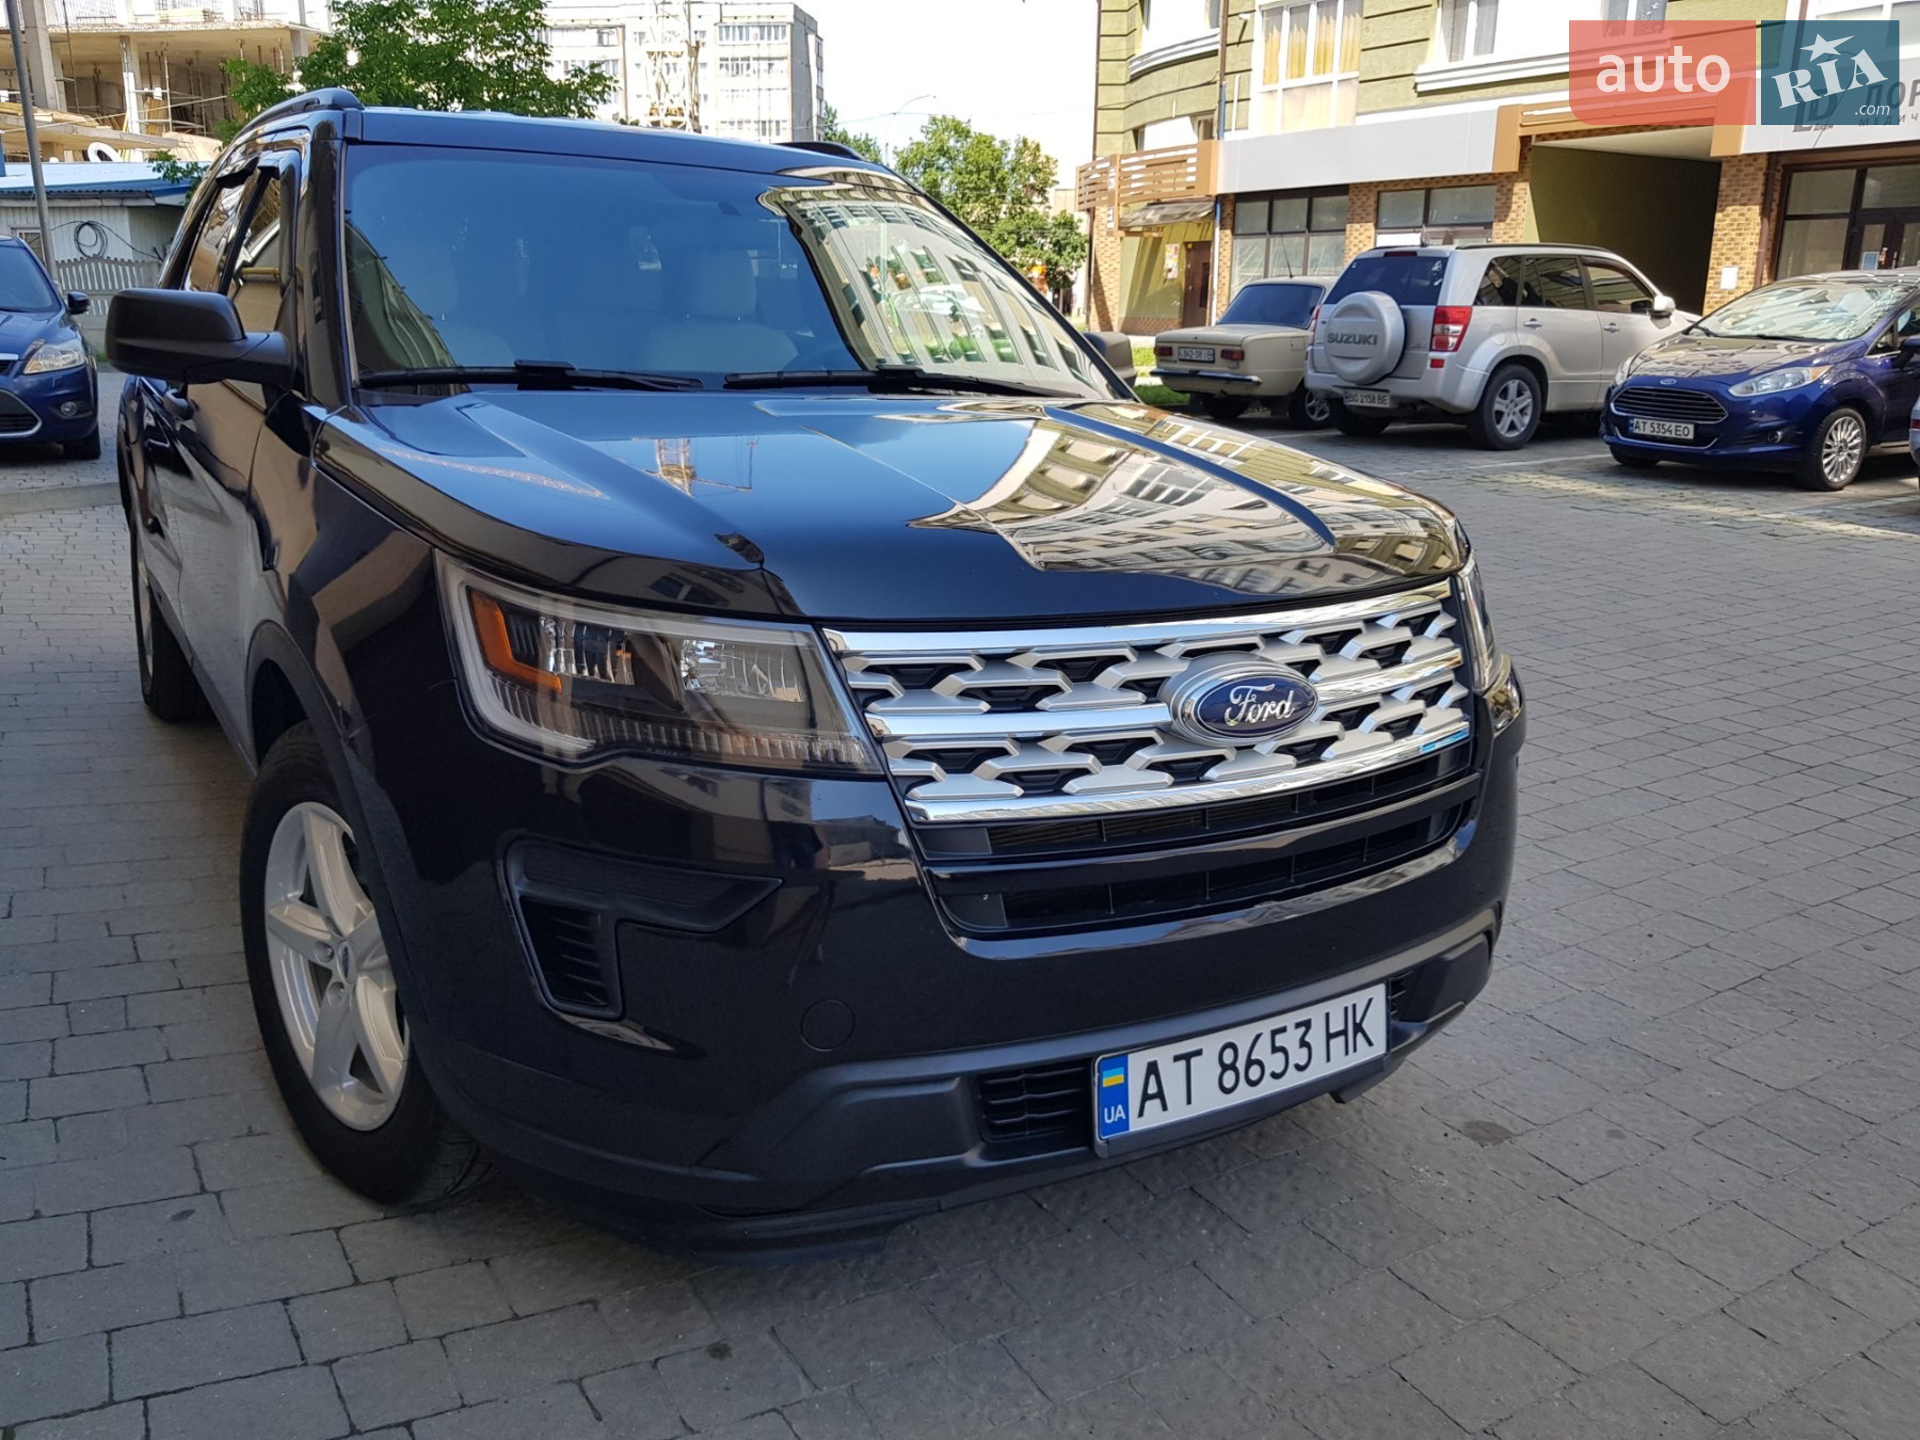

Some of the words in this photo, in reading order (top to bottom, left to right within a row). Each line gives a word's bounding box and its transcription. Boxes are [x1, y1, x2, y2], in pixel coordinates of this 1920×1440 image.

[1327, 332, 1378, 346] SUZUKI
[1634, 420, 1648, 432] AT
[1650, 422, 1673, 435] 5354
[1675, 424, 1690, 437] EO
[1224, 683, 1295, 727] Ford
[1137, 1048, 1204, 1118] AT
[1217, 1018, 1313, 1095] 8653
[1324, 997, 1375, 1063] HK
[1104, 1104, 1126, 1123] UA
